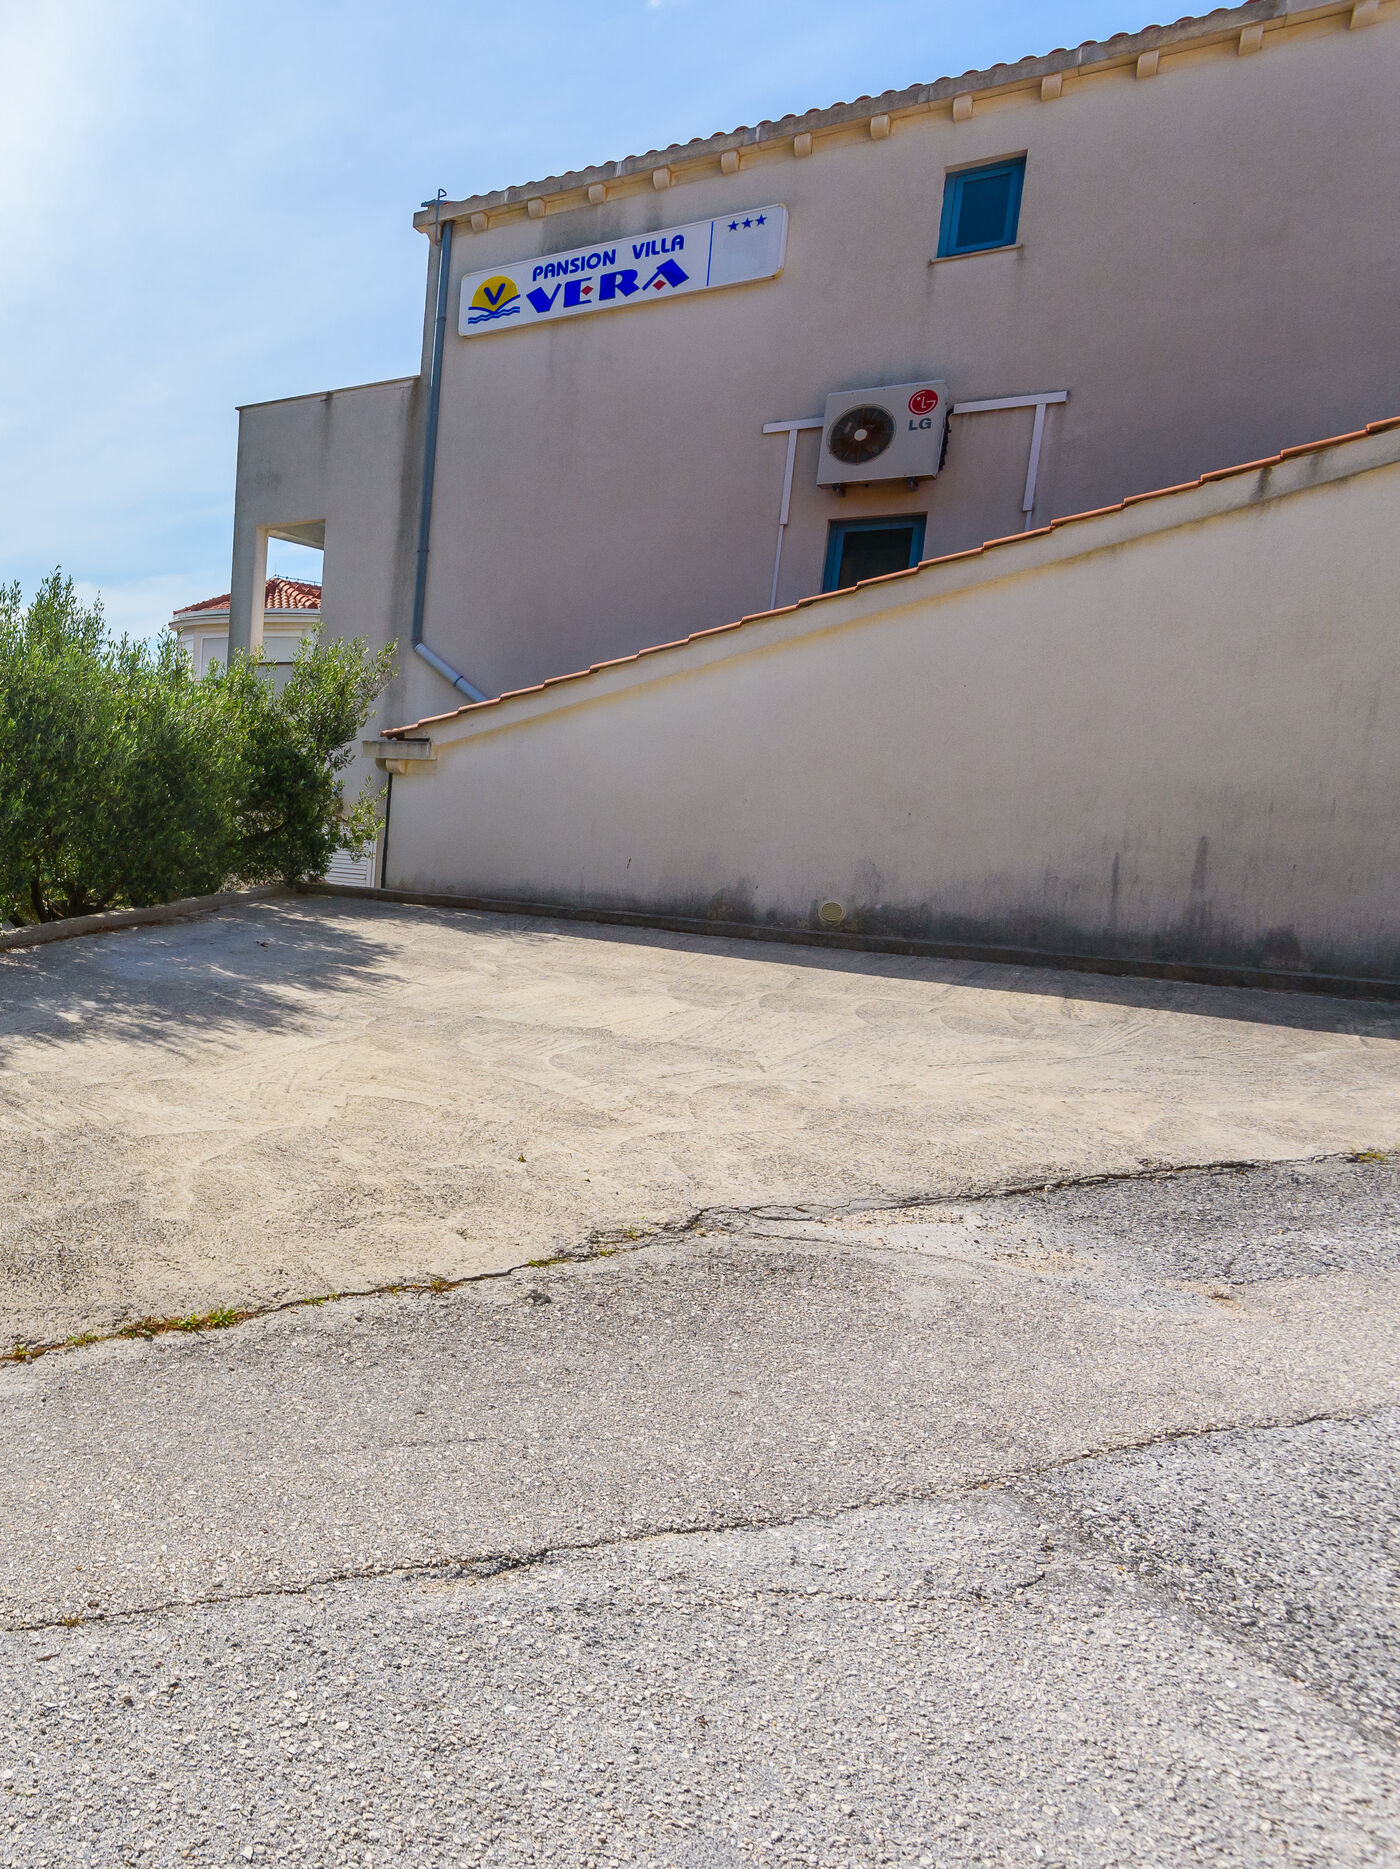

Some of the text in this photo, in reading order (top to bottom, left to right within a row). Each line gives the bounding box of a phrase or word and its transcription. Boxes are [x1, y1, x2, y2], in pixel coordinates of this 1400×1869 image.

[532, 234, 685, 281] PANSION VILLA
[526, 258, 689, 313] VERA
[908, 417, 932, 431] LG
